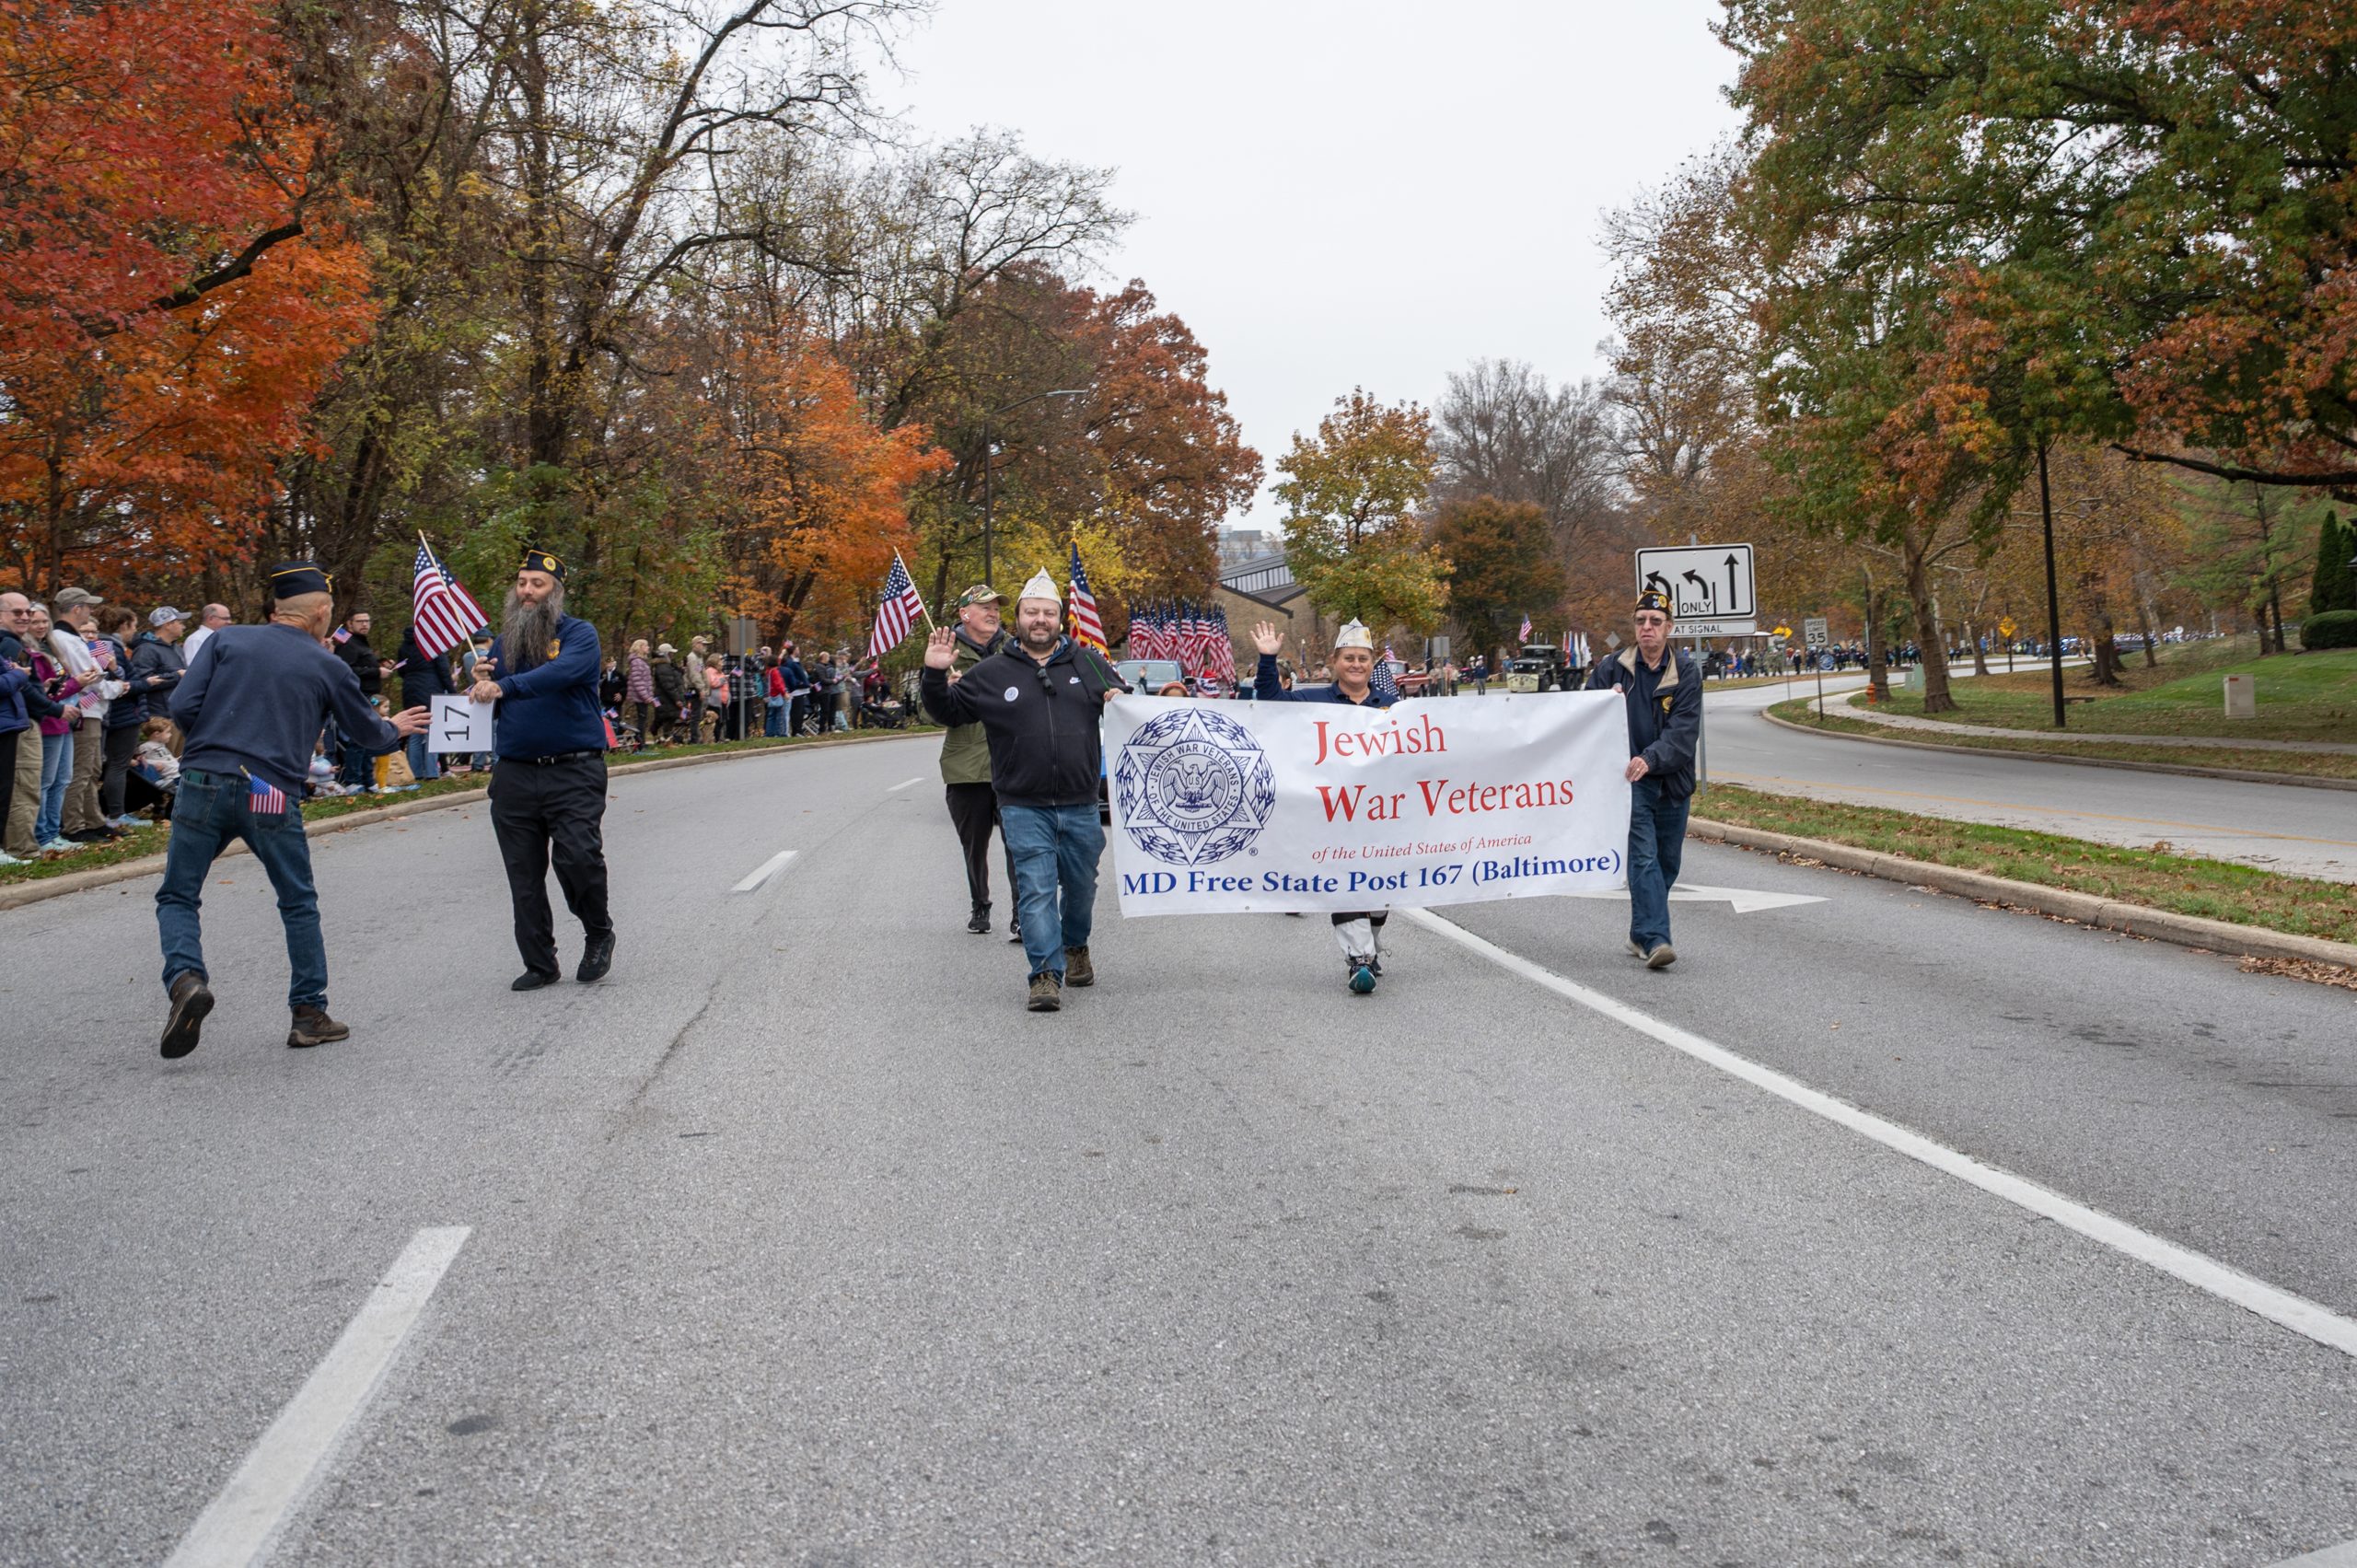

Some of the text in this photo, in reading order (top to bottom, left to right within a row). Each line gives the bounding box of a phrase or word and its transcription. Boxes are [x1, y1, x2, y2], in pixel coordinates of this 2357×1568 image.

[1681, 601, 1712, 613] ONLY
[1689, 624, 1723, 634] SIGNAL
[1807, 633, 1826, 644] 35
[445, 705, 470, 741] 17
[1313, 714, 1447, 765] Jewish
[1149, 744, 1239, 785] JEWISH WAR VETERANS
[1148, 793, 1238, 830] OF THE UNITED STATES
[1316, 780, 1573, 822] War Veterans
[1312, 833, 1532, 864] of the United States of America
[1123, 849, 1621, 896] MD Free State Post 167 (Baltimore)
